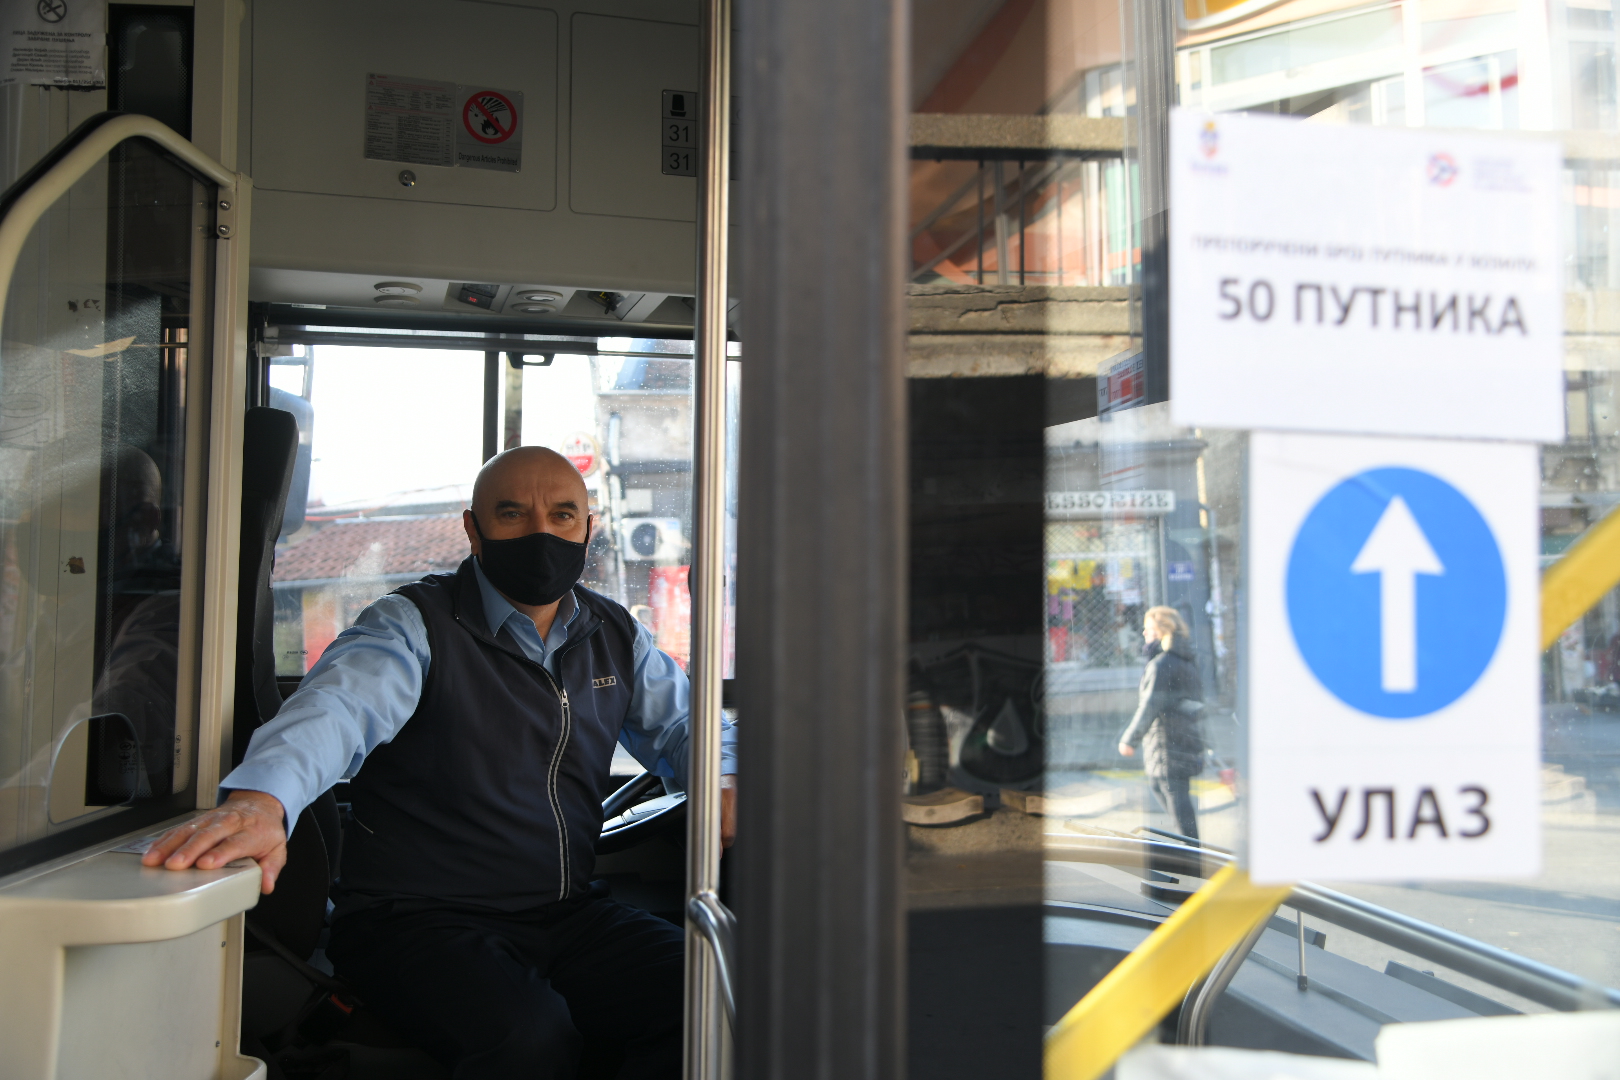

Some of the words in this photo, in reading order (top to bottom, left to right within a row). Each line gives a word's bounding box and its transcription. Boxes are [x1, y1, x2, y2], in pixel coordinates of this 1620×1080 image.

[669, 124, 689, 143] 31
[458, 152, 481, 163] Dangerous
[481, 155, 497, 164] Articles
[497, 156, 518, 166] Prohibited
[669, 152, 689, 171] 31
[1217, 277, 1276, 324] 50
[1293, 283, 1529, 336] ПУТНИКА
[593, 677, 616, 688] ALEX
[1307, 785, 1492, 844] УЛАЗ
